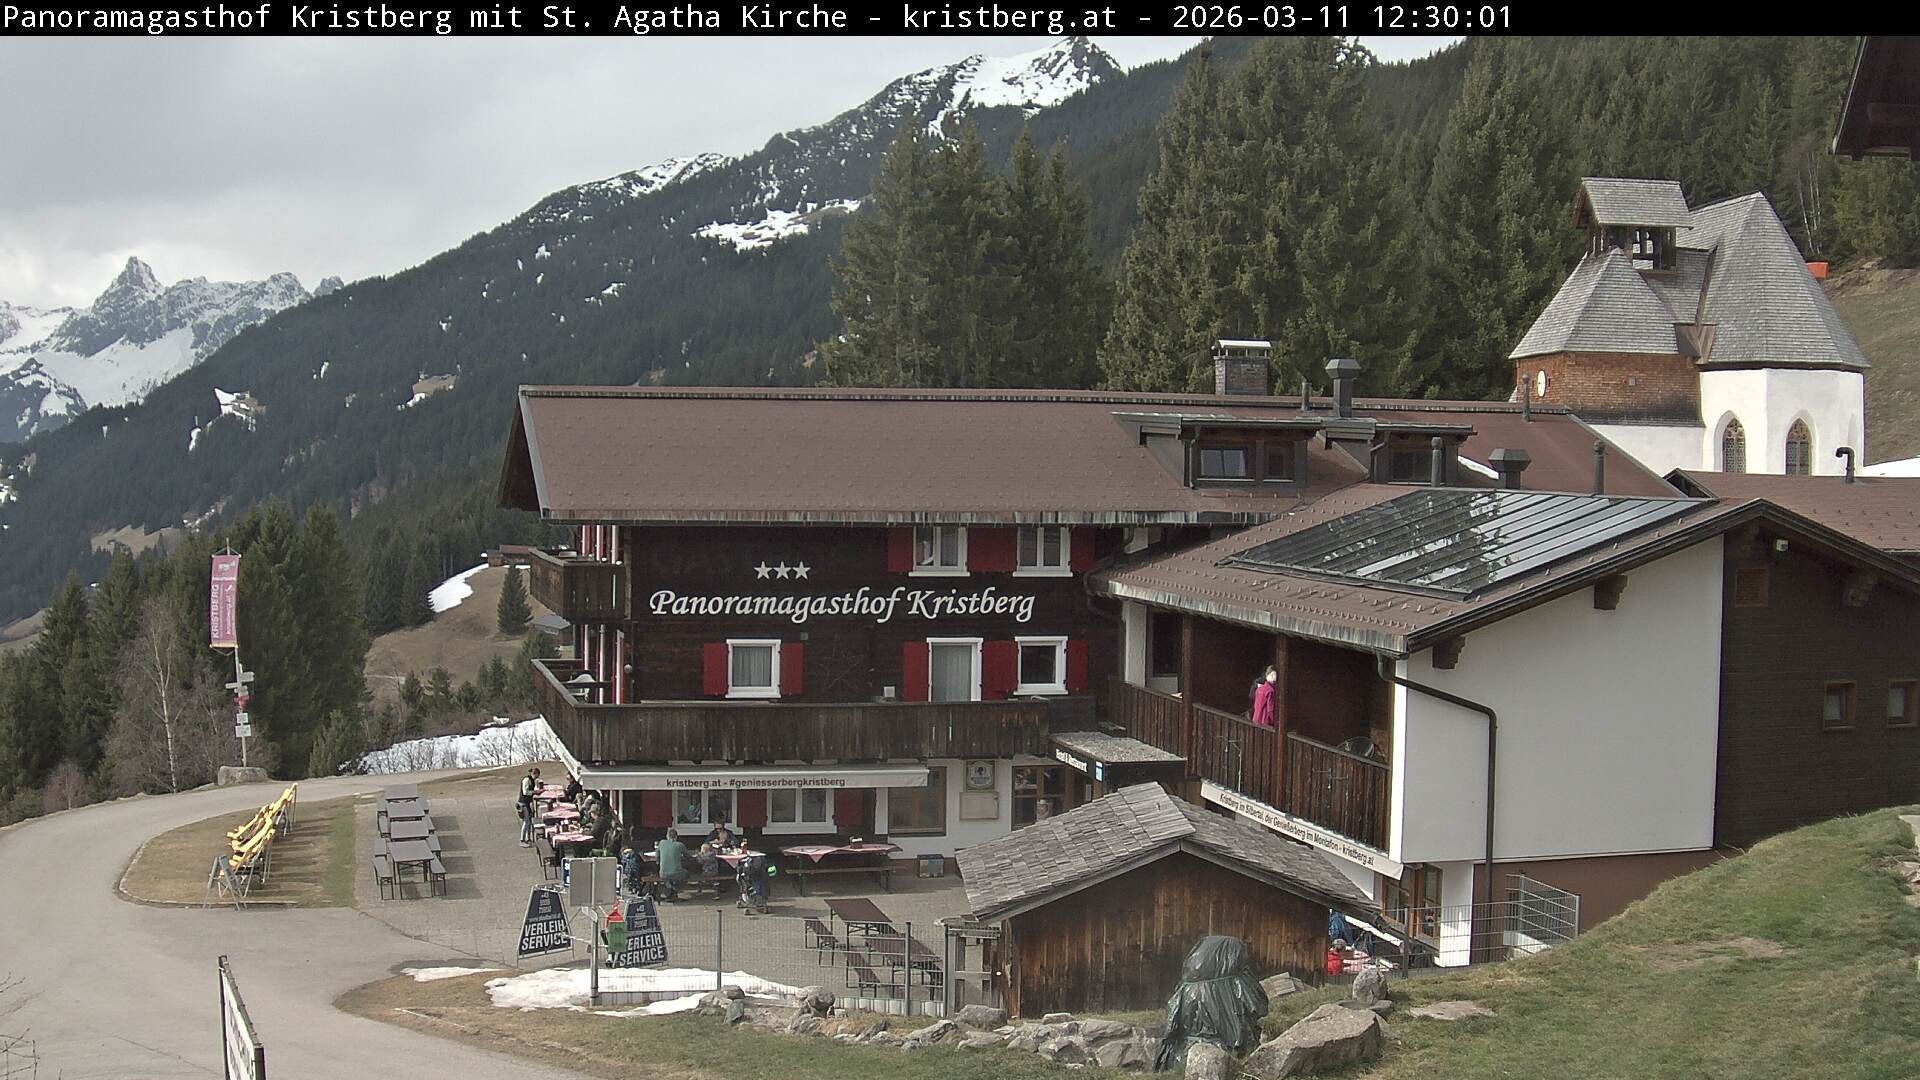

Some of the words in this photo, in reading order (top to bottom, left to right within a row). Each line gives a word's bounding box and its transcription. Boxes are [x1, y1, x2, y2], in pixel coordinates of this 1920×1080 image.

[211, 584, 220, 639] KRISTBERG
[649, 586, 906, 624] Panoramagasthof
[906, 586, 1036, 623] Kristberg
[666, 778, 721, 789] kristberg.at
[729, 777, 846, 788] #geniesserbergkristberg
[1220, 793, 1240, 812] Kristberg
[1264, 814, 1274, 824] der
[1314, 832, 1339, 852] Montafon
[525, 919, 567, 937] VERLEIH
[521, 932, 568, 951] SERVICE
[626, 932, 662, 951] ERLEIH
[619, 946, 665, 967] SERVICE
